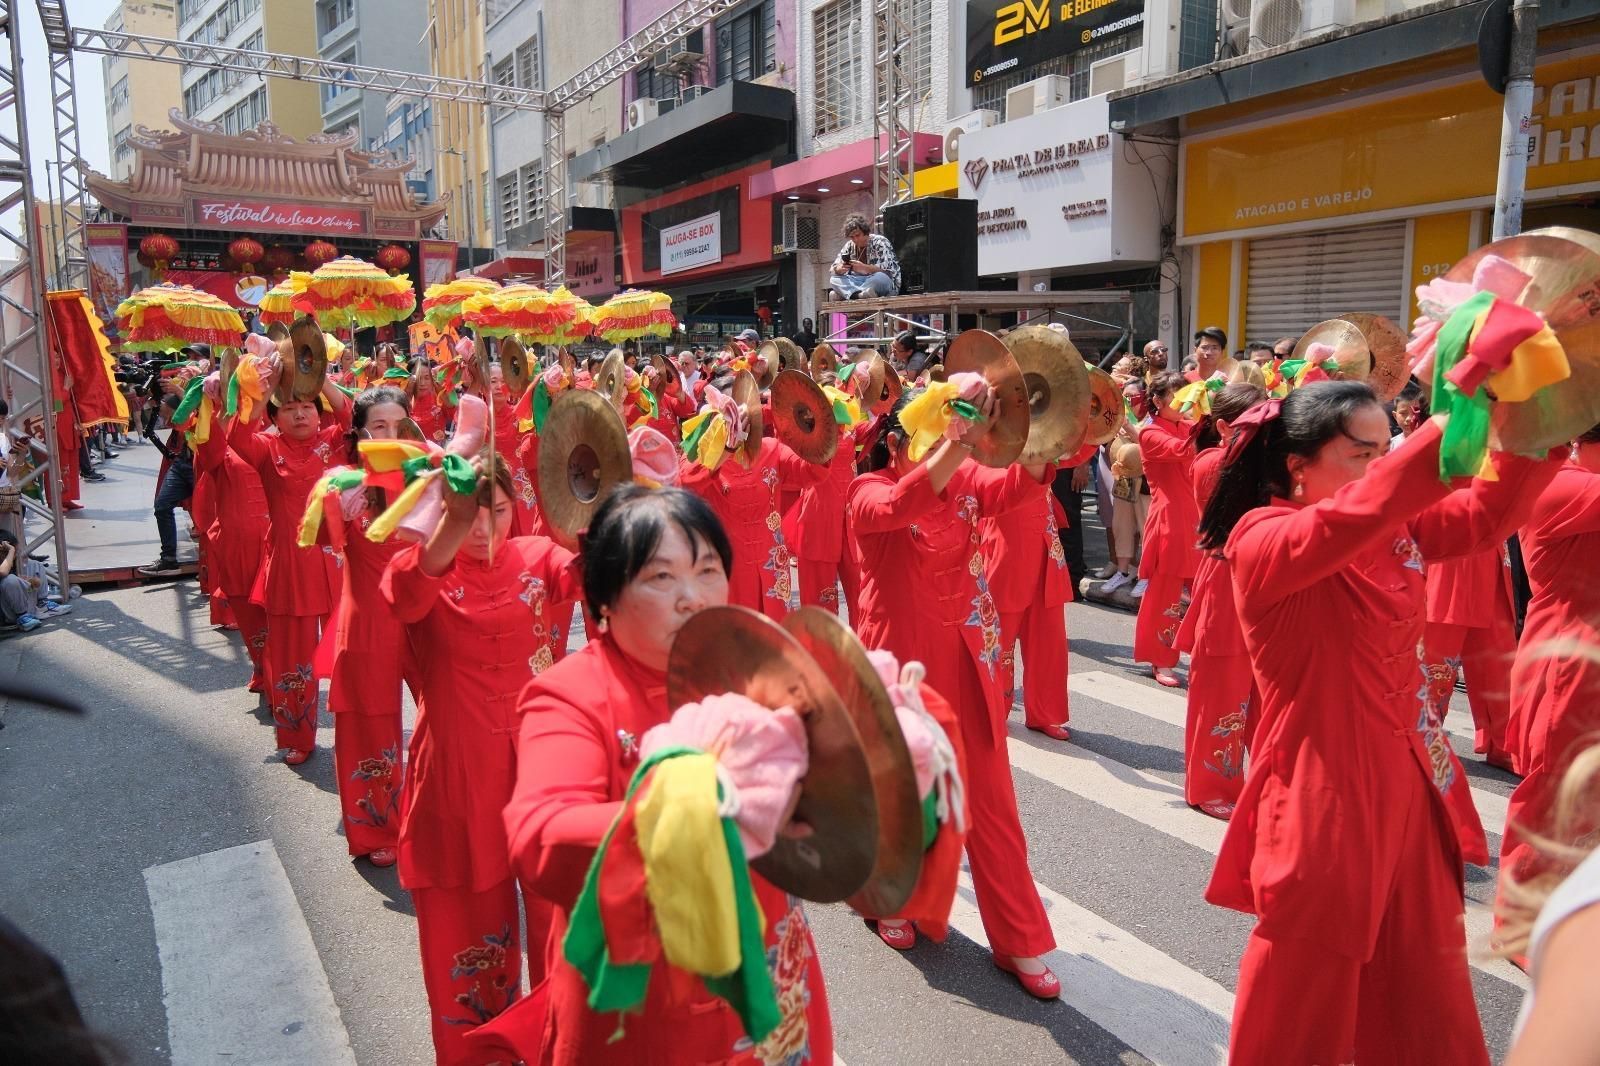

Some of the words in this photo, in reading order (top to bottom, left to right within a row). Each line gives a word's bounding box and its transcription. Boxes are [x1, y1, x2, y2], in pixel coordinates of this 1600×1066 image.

[1060, 2, 1073, 21] DE
[992, 153, 1031, 174] PRATA
[1034, 147, 1053, 165] DE
[1054, 143, 1066, 161] 15
[201, 202, 275, 224] Festival
[275, 213, 291, 224] da
[289, 210, 323, 226] Lua
[1235, 200, 1297, 220] ATACADO
[1301, 198, 1309, 209] E
[1314, 186, 1373, 208] VAREJO
[665, 228, 698, 247] ALUGA-SE
[699, 223, 715, 237] BOX
[1422, 262, 1450, 276] 912
